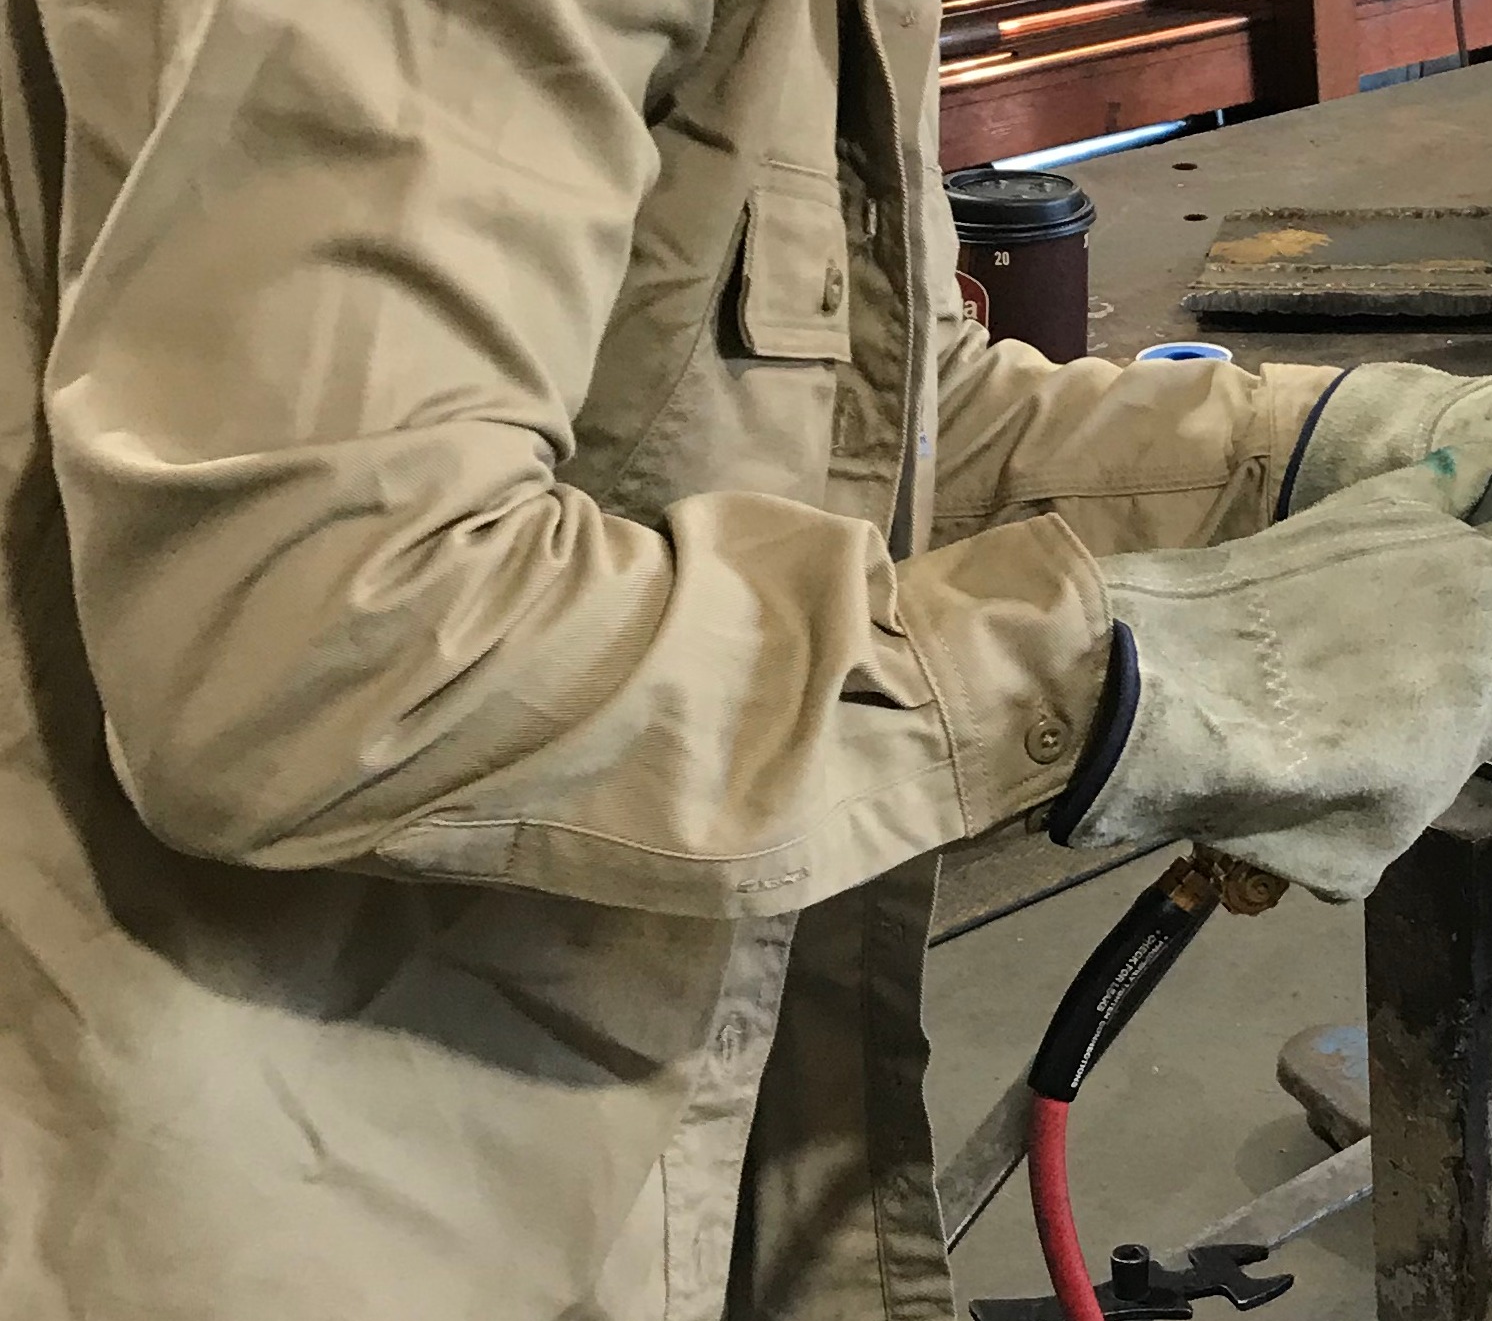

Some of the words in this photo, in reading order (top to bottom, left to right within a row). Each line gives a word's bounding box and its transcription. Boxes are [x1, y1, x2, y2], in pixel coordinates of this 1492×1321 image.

[994, 251, 1010, 266] 20
[1129, 934, 1157, 965] CHECK
[1115, 964, 1133, 982] FOR
